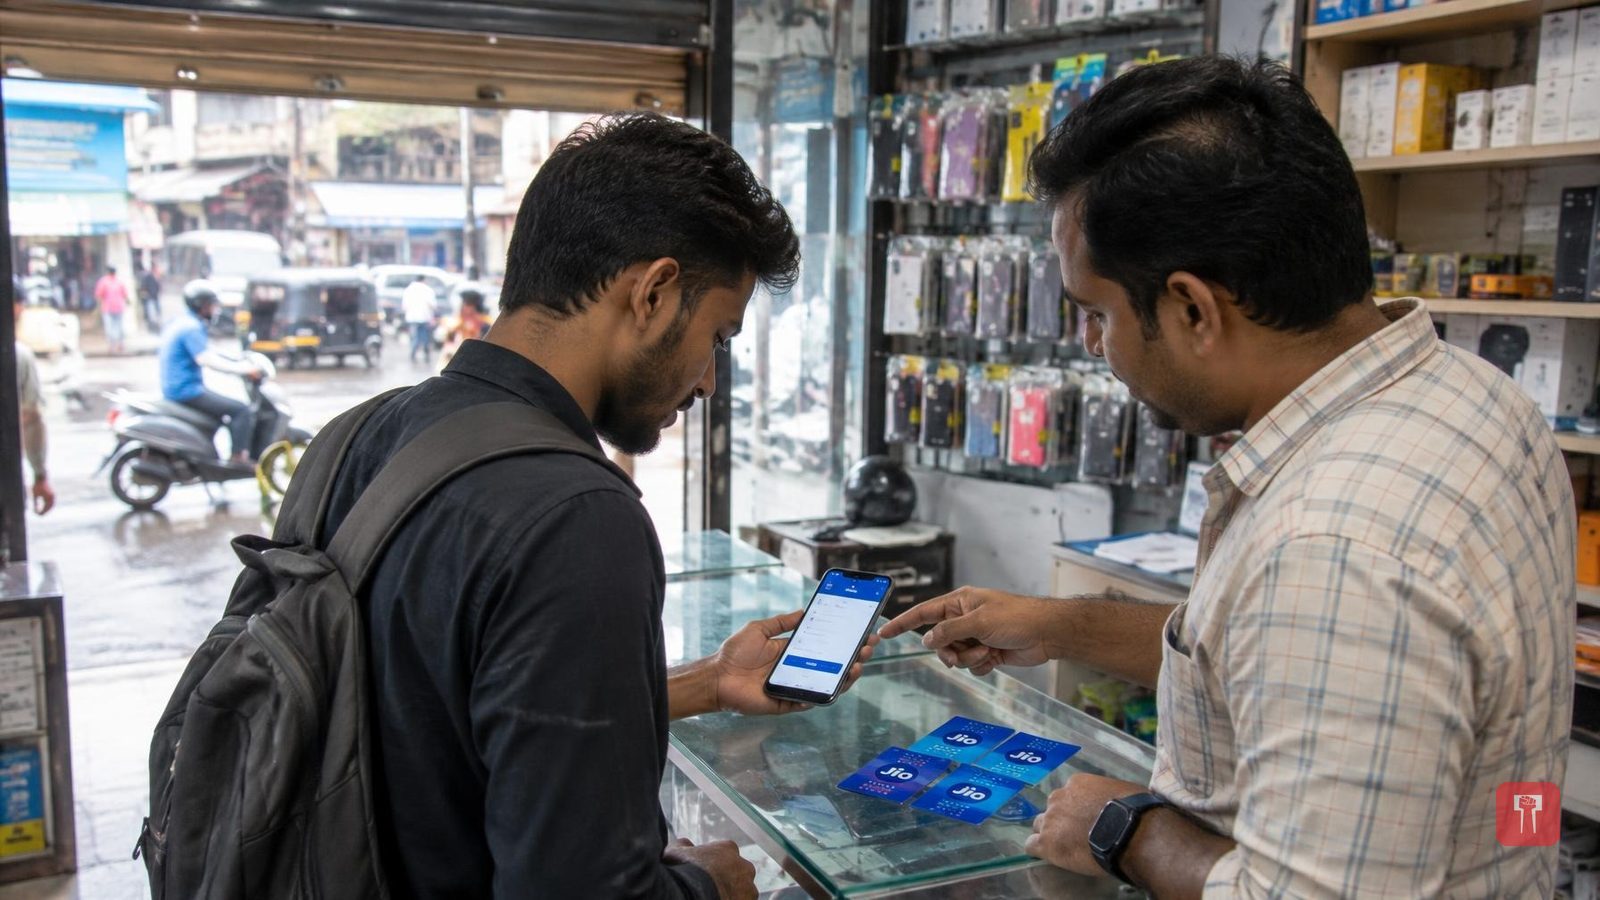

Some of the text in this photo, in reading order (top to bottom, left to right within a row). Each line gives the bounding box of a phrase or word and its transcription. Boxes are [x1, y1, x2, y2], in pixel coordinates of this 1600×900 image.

[947, 733, 978, 746] Jio
[1010, 749, 1042, 763] Jio
[880, 767, 913, 780] Jio
[952, 786, 985, 800] Jio
